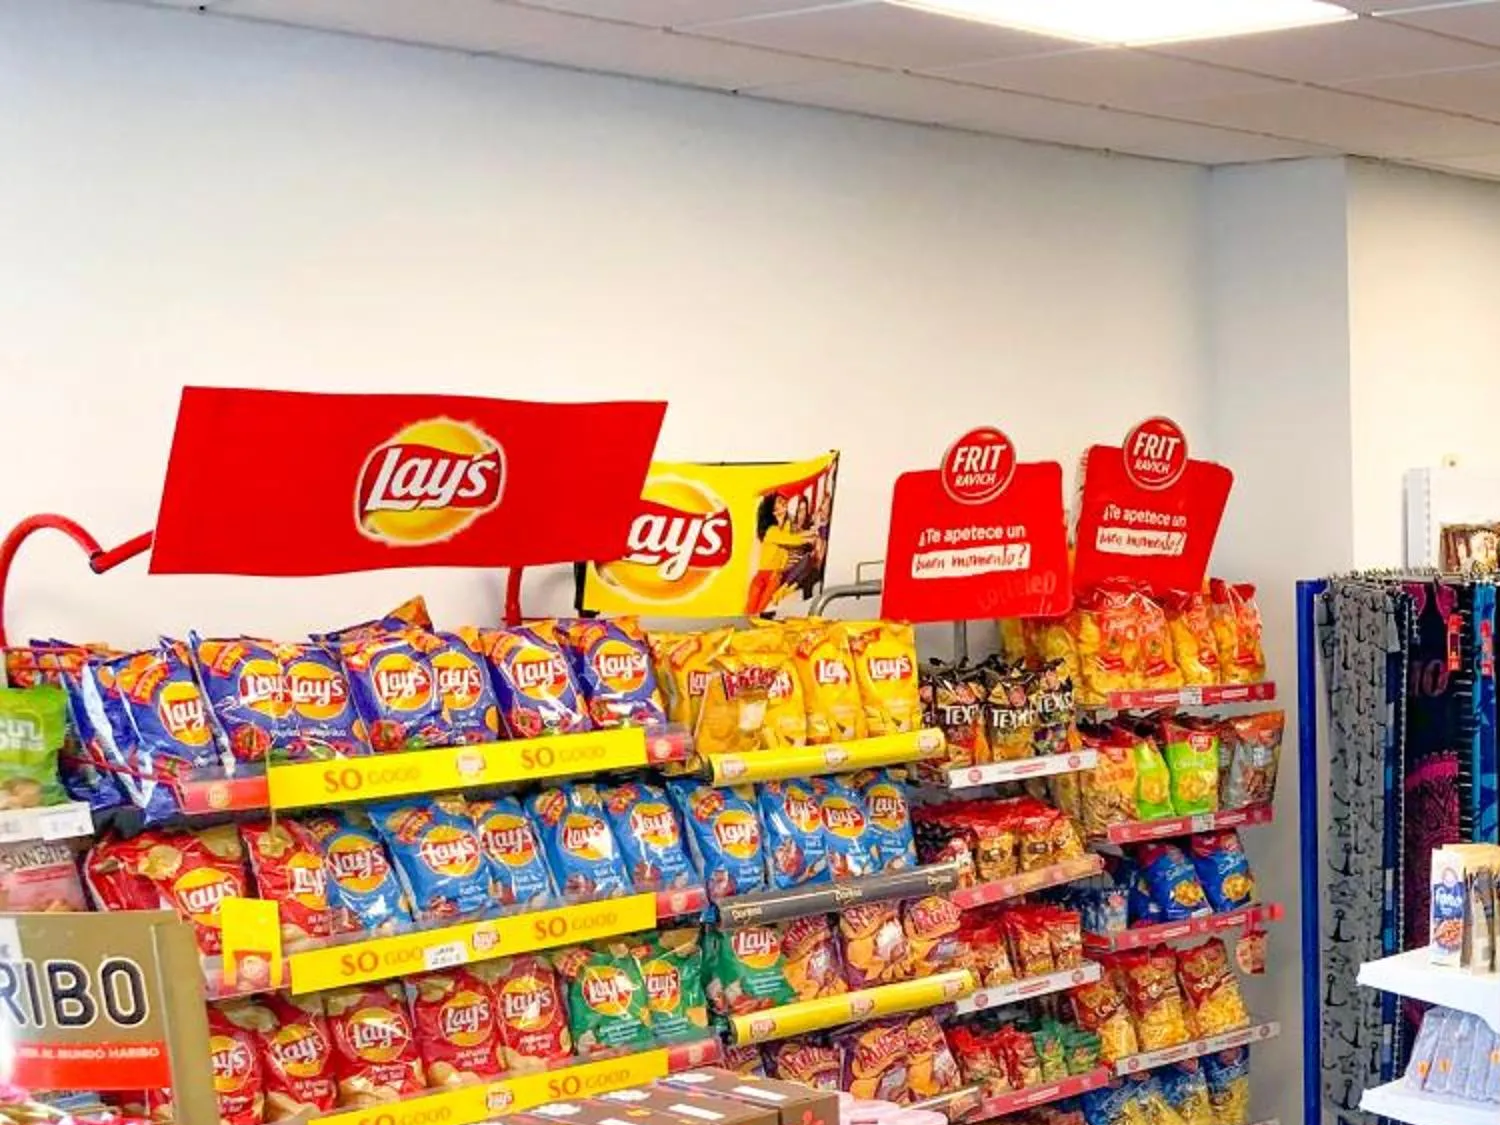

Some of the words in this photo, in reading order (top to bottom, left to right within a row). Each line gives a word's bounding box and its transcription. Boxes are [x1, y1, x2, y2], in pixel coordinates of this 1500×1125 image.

[1133, 432, 1180, 460] FRIT
[951, 445, 1006, 473] FRIT
[1133, 459, 1170, 475] RAVICH
[364, 445, 498, 512] Lay's
[954, 473, 996, 487] RAVICH
[1122, 507, 1171, 525] apetece
[1172, 515, 1187, 527] un
[626, 512, 726, 582] ay's
[943, 525, 1003, 544] apetece
[1006, 525, 1026, 540] un
[522, 747, 555, 770] SO
[323, 767, 363, 794] SO
[533, 917, 567, 940] SO
[340, 949, 379, 977] SO
[446, 1003, 490, 1032] Lay's
[548, 1075, 582, 1099] SO
